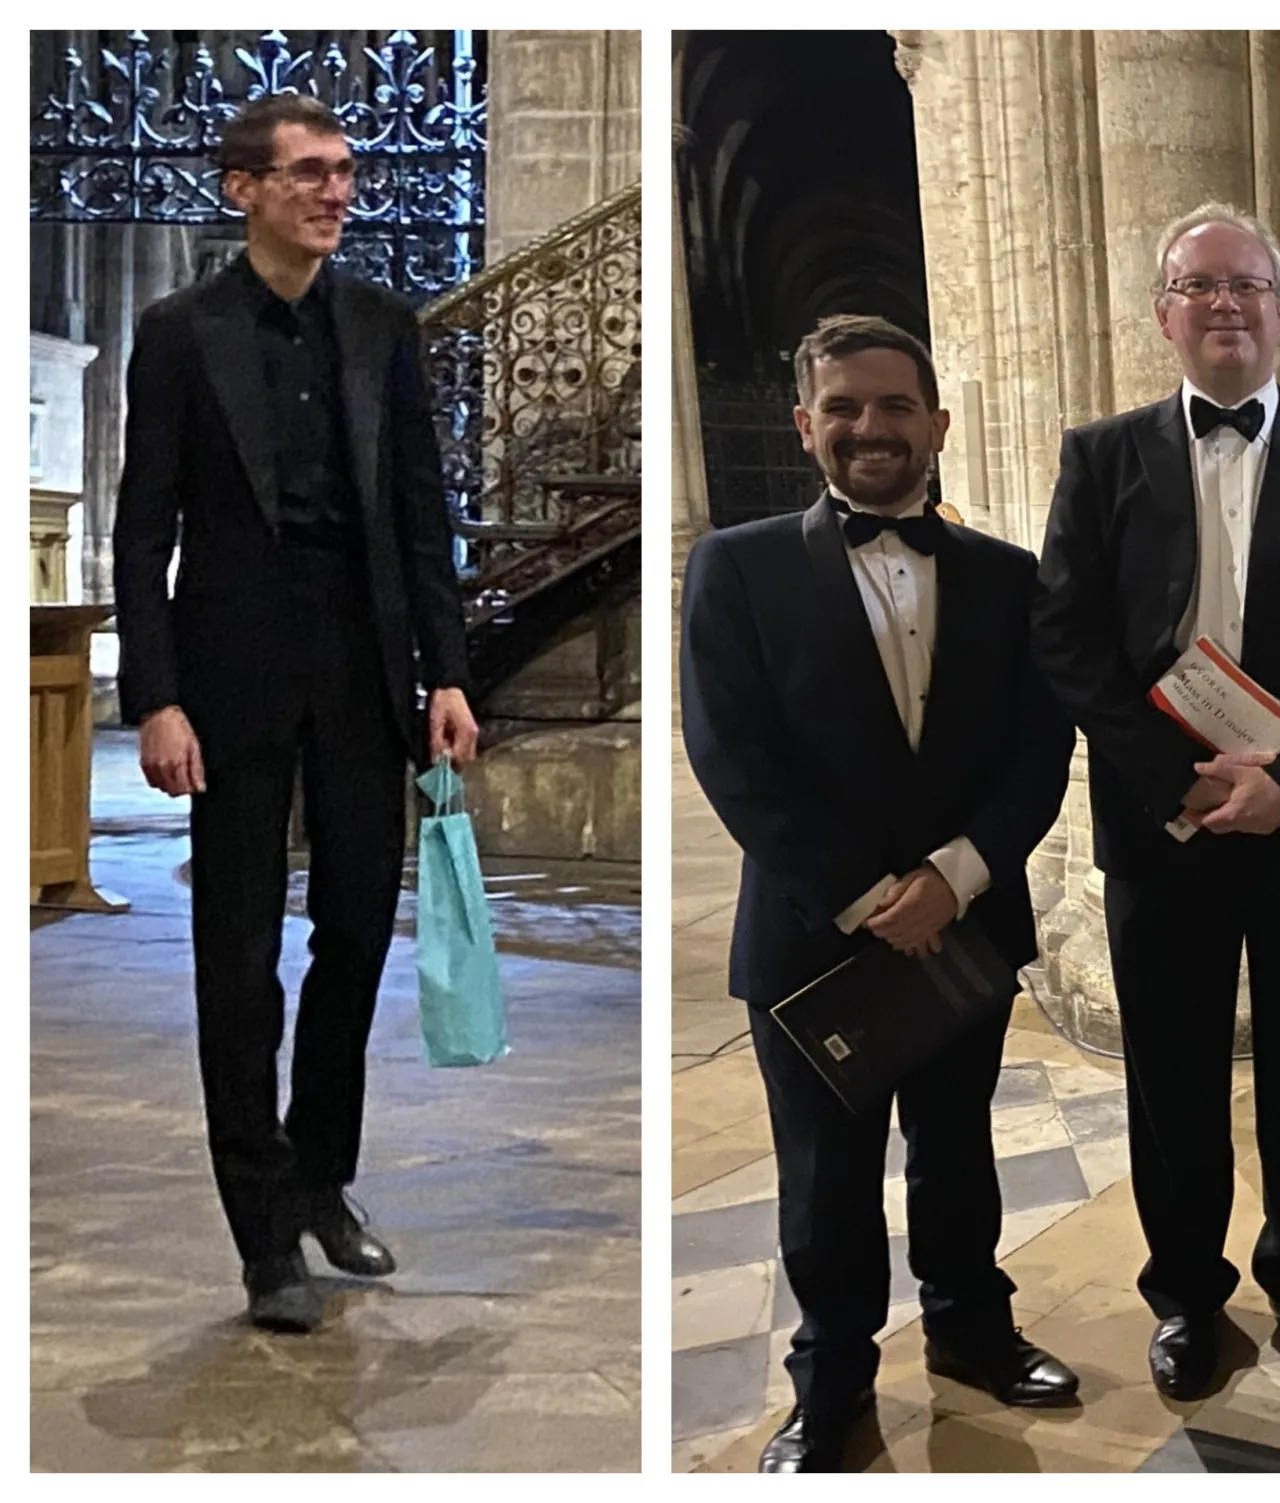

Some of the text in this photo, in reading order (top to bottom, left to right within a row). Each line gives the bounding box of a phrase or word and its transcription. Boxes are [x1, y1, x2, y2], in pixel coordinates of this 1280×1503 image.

[1180, 673, 1200, 699] Mass
[1201, 697, 1213, 711] in
[1213, 708, 1225, 719] D
[1224, 719, 1256, 744] major
